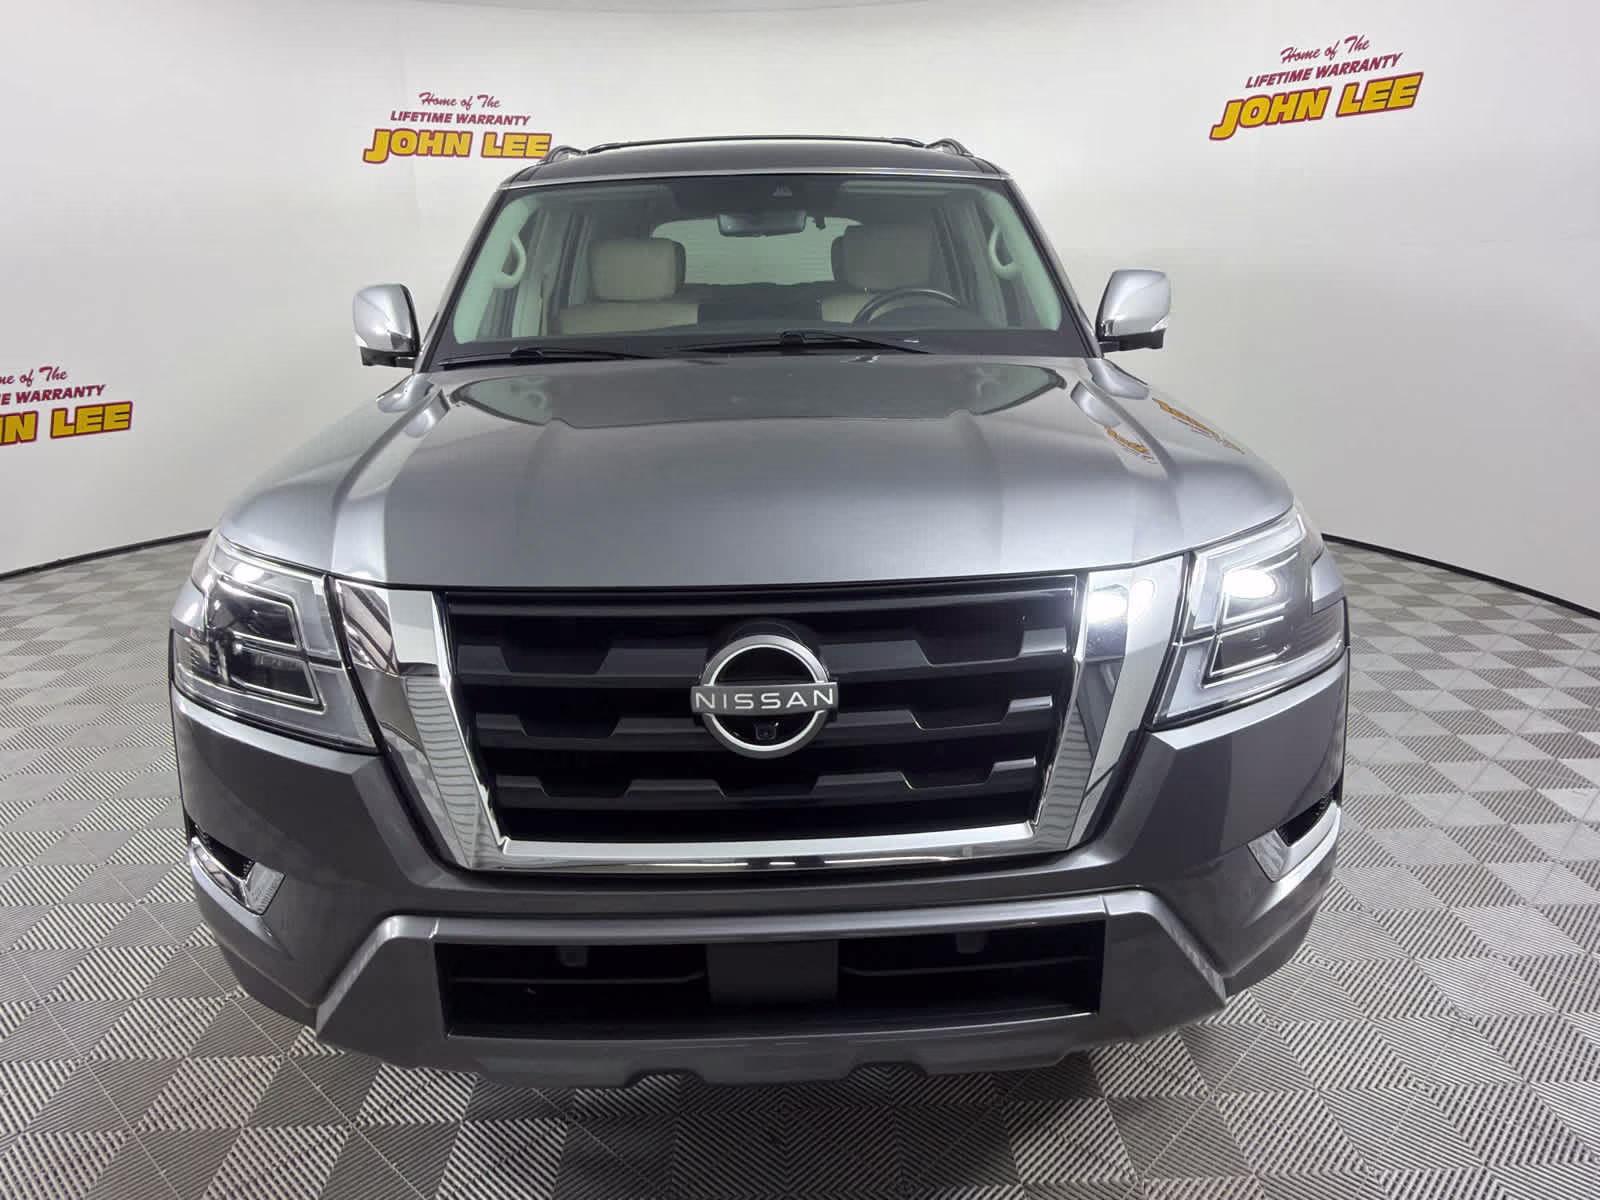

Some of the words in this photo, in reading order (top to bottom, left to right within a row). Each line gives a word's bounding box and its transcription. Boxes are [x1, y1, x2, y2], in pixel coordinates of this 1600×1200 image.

[1280, 47, 1320, 63] Home
[1324, 41, 1339, 60] of
[1344, 35, 1370, 53] The
[1245, 68, 1312, 88] LIFETIME
[1315, 52, 1403, 79] WARRANTY
[418, 92, 457, 107] Home
[460, 95, 474, 110] of
[477, 95, 501, 108] The
[1209, 86, 1332, 140] JOHN
[1336, 72, 1424, 118] LEE
[390, 111, 453, 123] LIFETIME
[456, 113, 531, 126] WARRANTY
[363, 128, 473, 164] JOHN
[481, 131, 552, 159] LEE
[19, 369, 34, 387] of
[39, 366, 68, 381] The
[15, 384, 106, 404] WARRANTY
[50, 401, 133, 439] LEE
[695, 688, 833, 710] NISSAN
